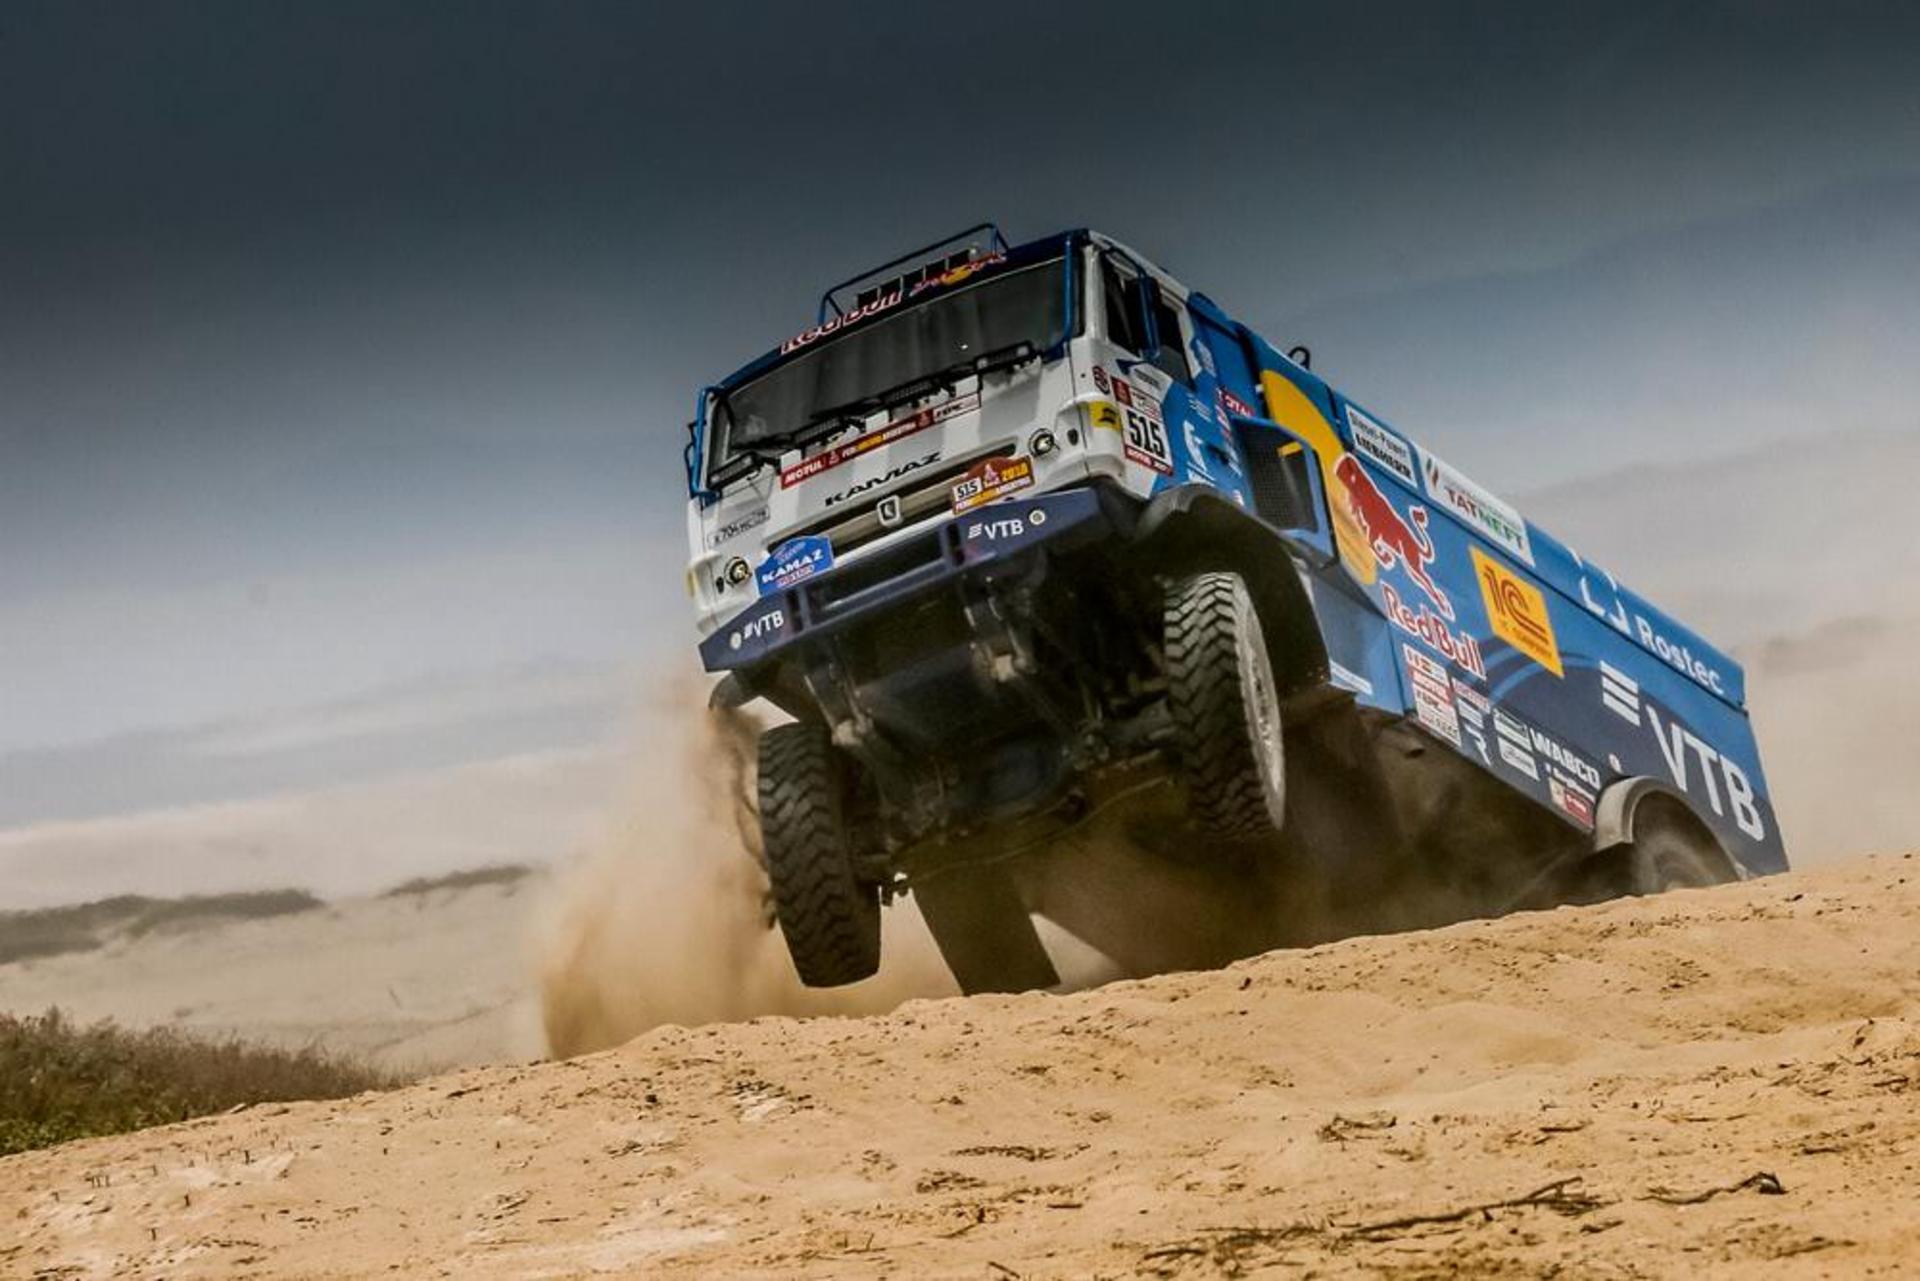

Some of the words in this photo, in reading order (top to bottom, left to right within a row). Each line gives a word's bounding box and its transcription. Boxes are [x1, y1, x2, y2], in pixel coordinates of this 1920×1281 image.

[1126, 409, 1166, 459] 515
[784, 461, 823, 486] MOTUL
[824, 451, 942, 507] KAMAZ
[957, 480, 978, 499] 515
[983, 518, 1024, 540] VTB
[761, 548, 824, 584] KAMAZ
[753, 610, 785, 638] VTB
[1380, 579, 1438, 650] Red
[1430, 611, 1487, 681] Bull
[1634, 613, 1726, 696] Rostec
[1529, 727, 1601, 791] WABCO
[1645, 703, 1766, 842] VTB
